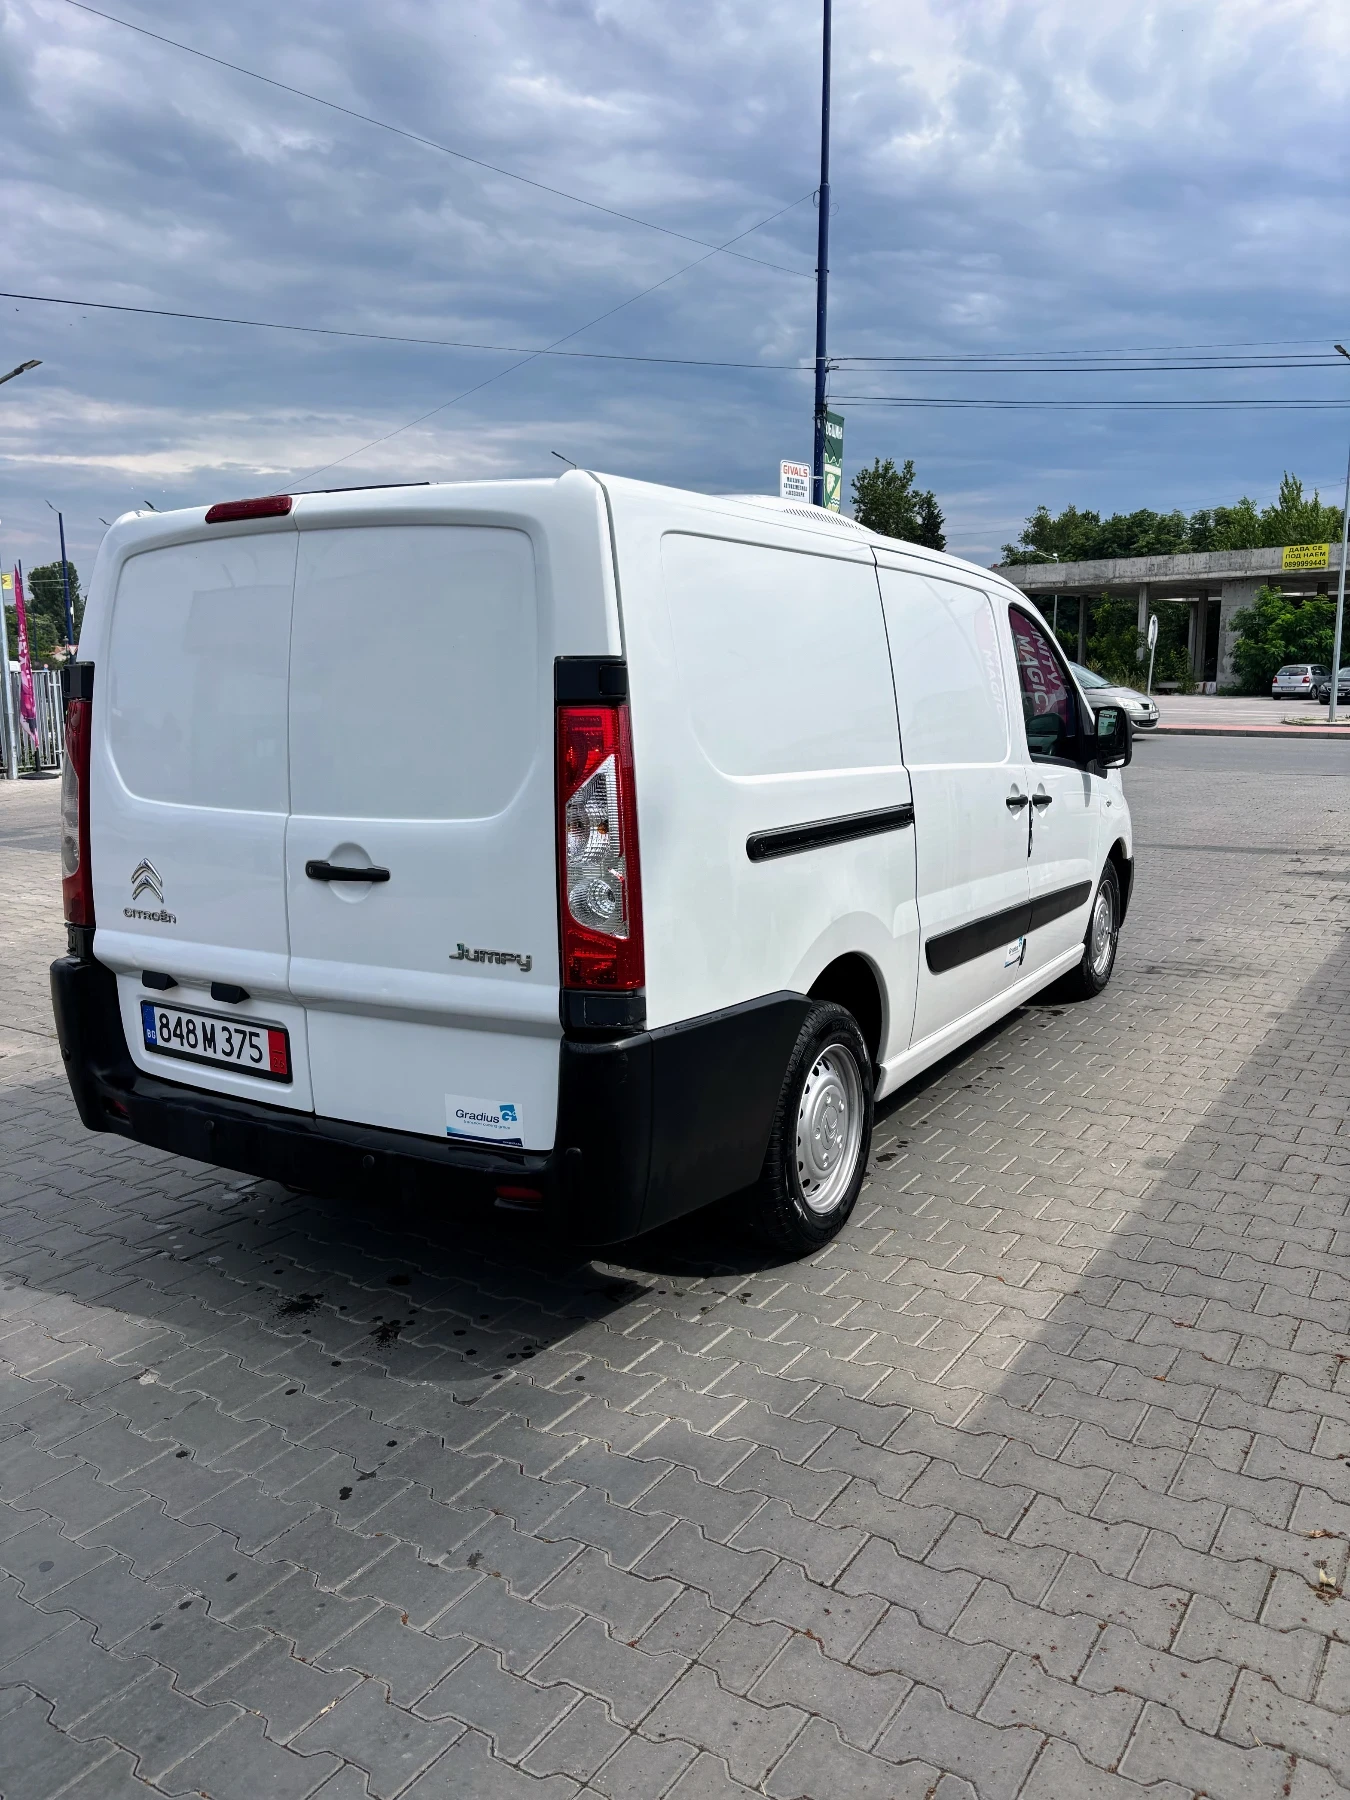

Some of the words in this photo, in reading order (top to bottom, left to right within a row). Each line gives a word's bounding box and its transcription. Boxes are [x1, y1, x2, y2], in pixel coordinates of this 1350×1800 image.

[783, 464, 808, 478] GIVALS
[1016, 634, 1049, 707] MAGIC
[147, 1028, 156, 1039] BG
[455, 1108, 500, 1124] Gradius
